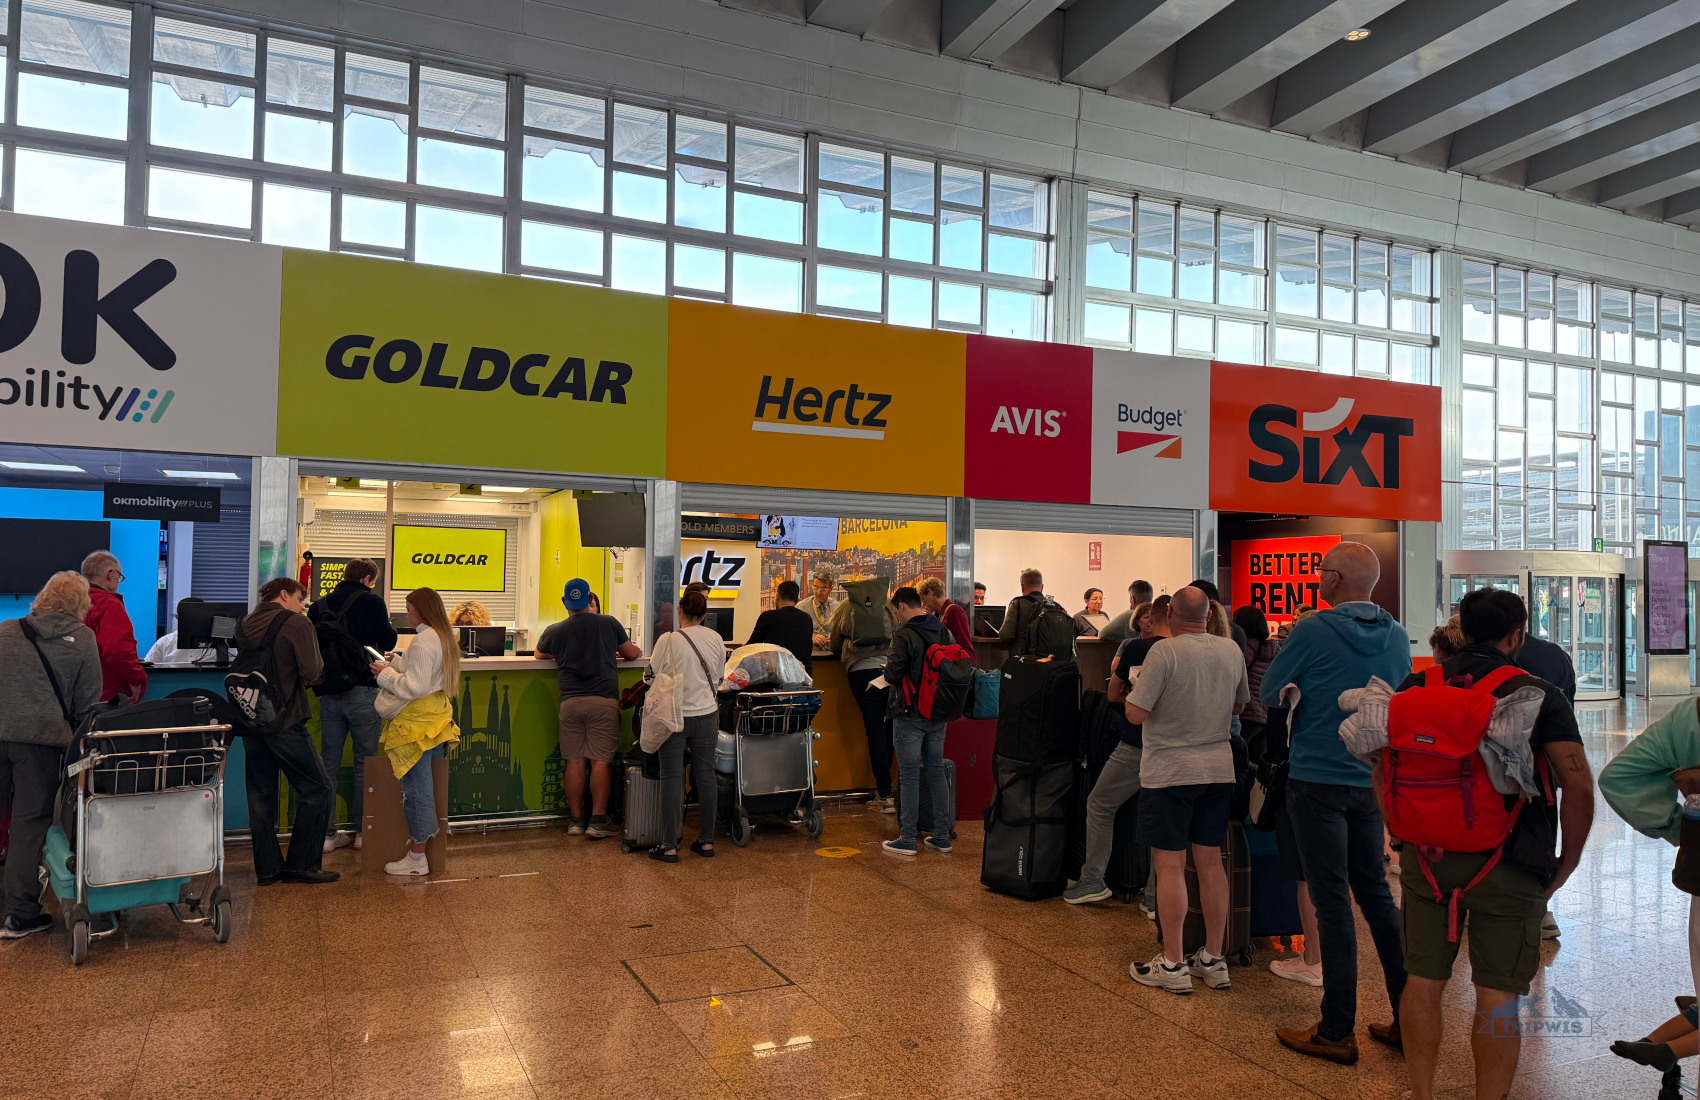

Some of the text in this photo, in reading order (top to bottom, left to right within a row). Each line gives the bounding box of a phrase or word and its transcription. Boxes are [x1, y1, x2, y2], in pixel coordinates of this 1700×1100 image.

[325, 334, 633, 405] GOLDCAR
[754, 375, 892, 427] Hertz
[1117, 403, 1183, 431] Budget
[188, 500, 213, 509] PLUS
[704, 523, 755, 535] MEMBERS
[411, 553, 488, 566] GOLDCAR
[680, 550, 746, 586] rtz
[1250, 552, 1323, 576] BETTER
[320, 572, 344, 581] FAST,
[1250, 582, 1320, 615] RENT
[228, 686, 257, 719] adidas
